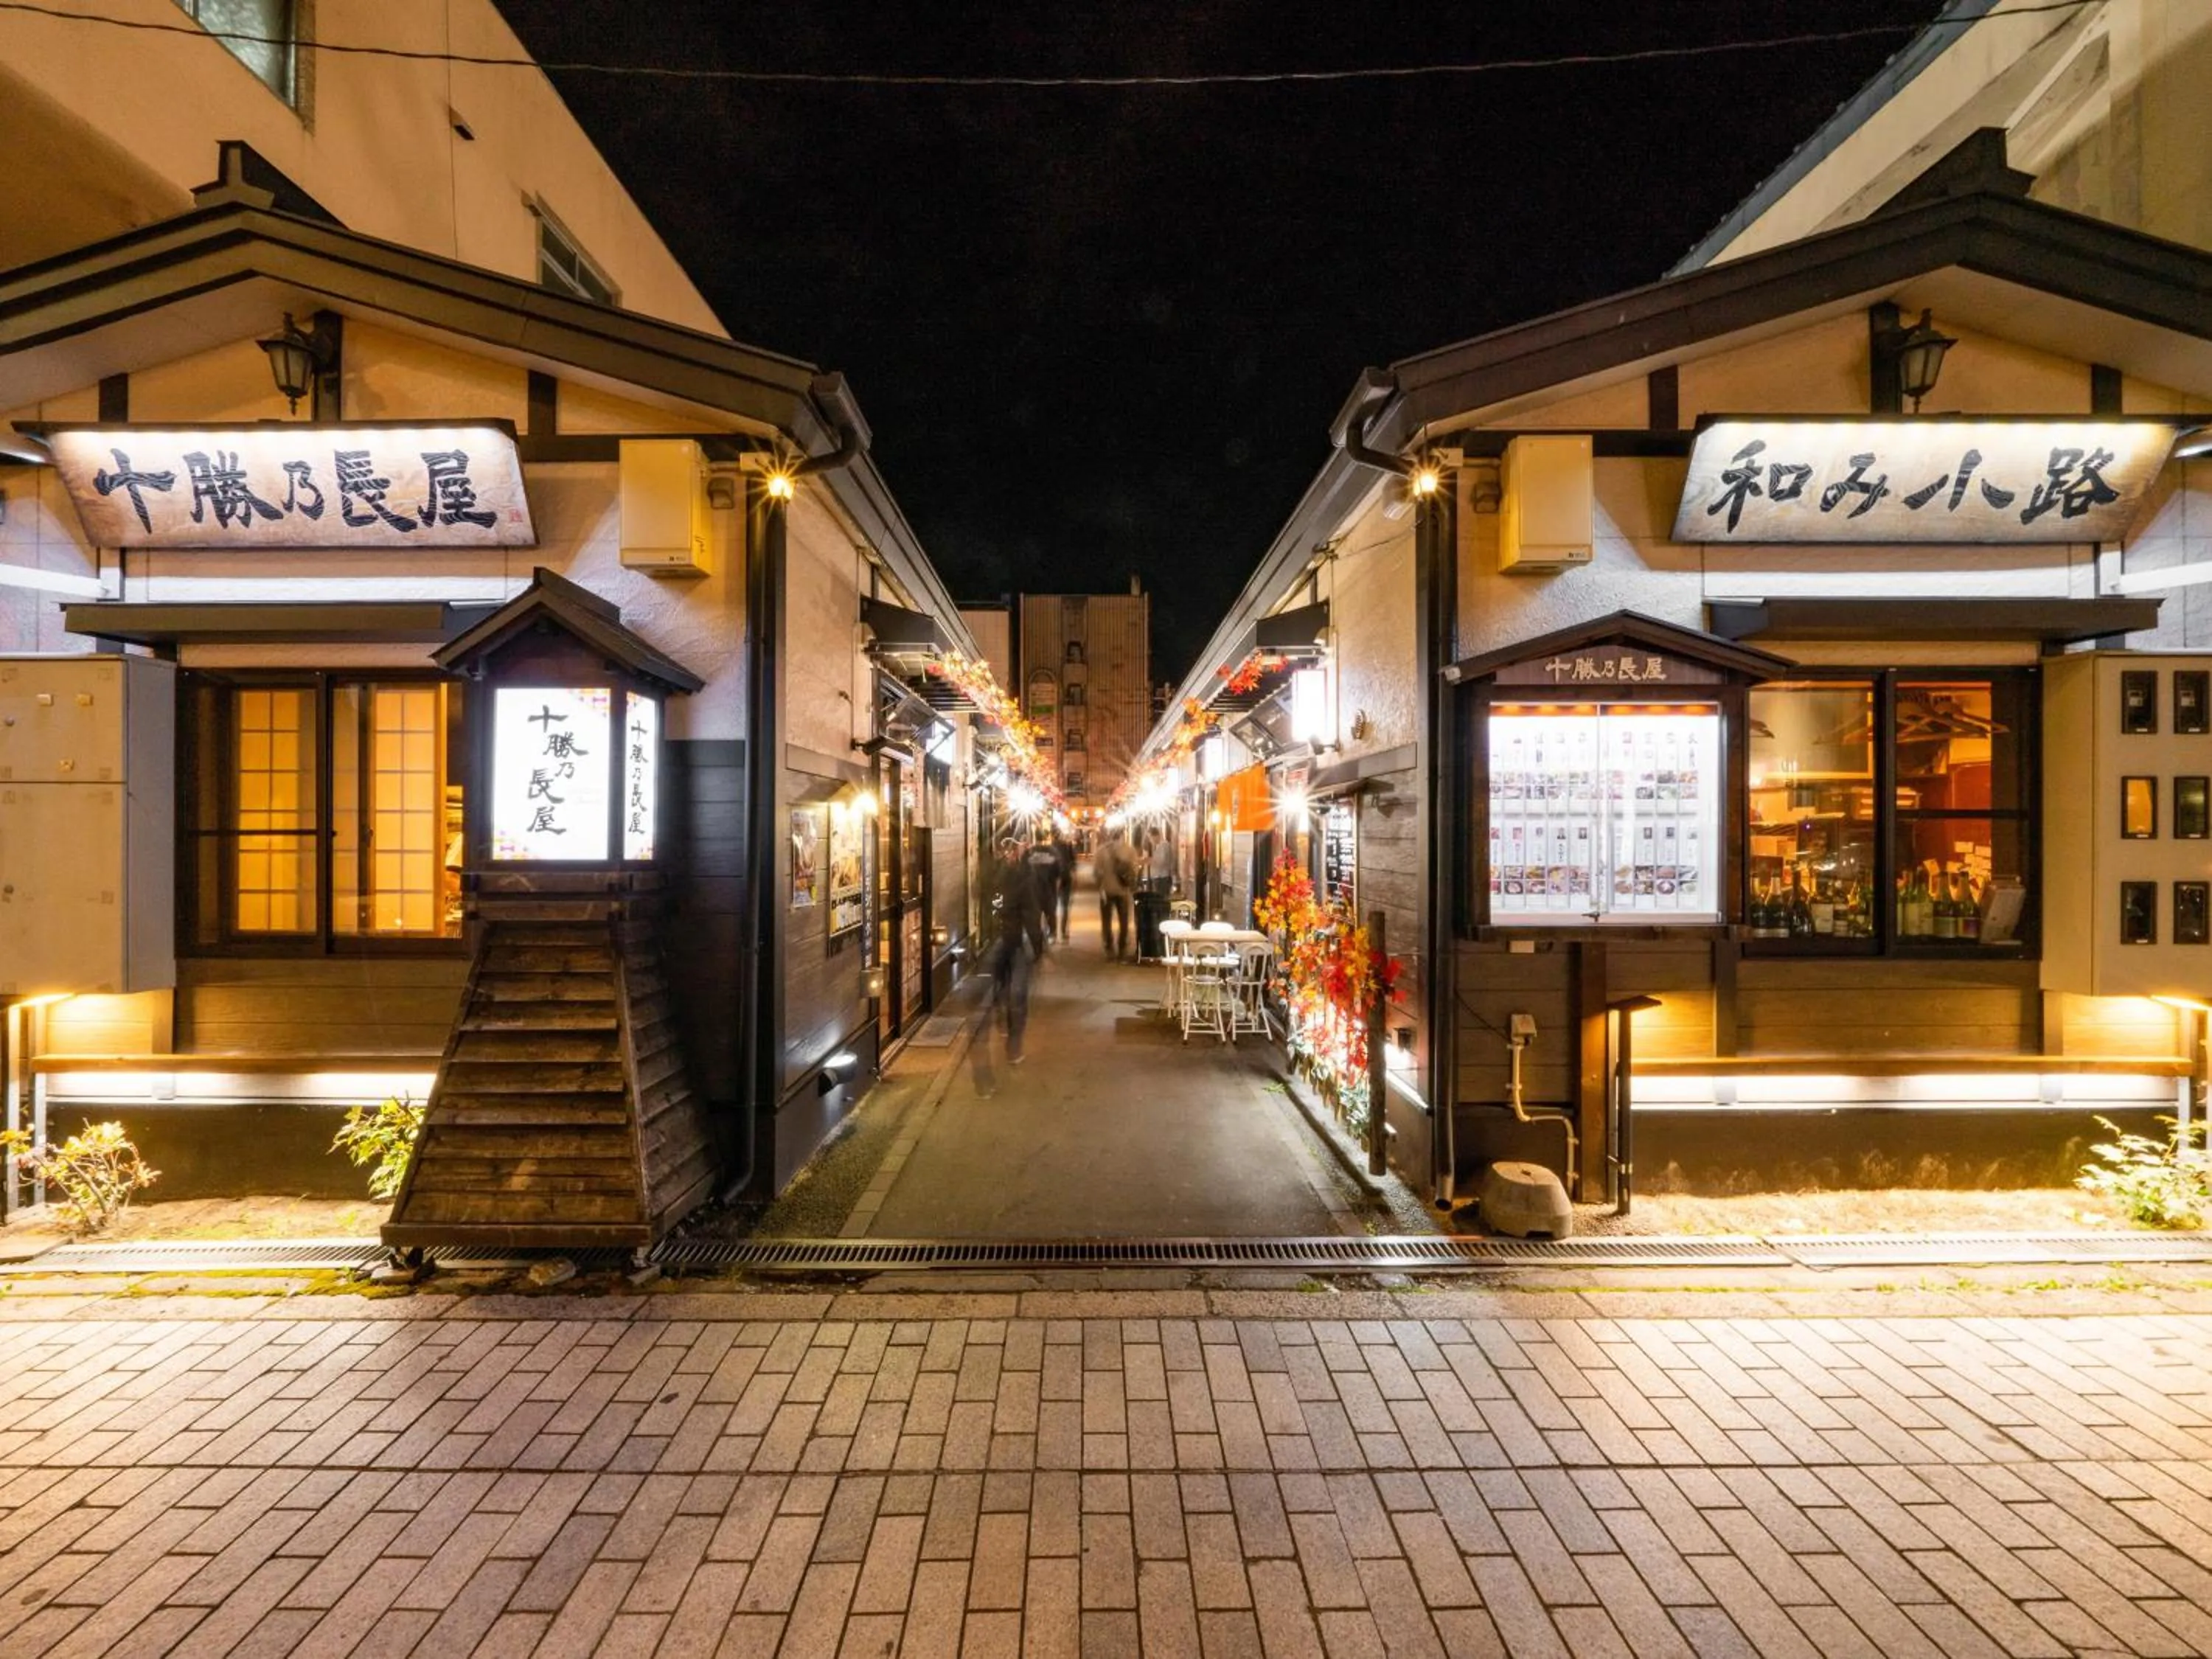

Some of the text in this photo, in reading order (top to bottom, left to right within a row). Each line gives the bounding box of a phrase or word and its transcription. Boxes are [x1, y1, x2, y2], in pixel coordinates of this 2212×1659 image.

[92, 448, 498, 535] 十勝乃長屋
[1707, 439, 2121, 533] 和み小路
[1545, 656, 1667, 681] 十勝乃長屋
[526, 705, 589, 835] 十勝乃長屋
